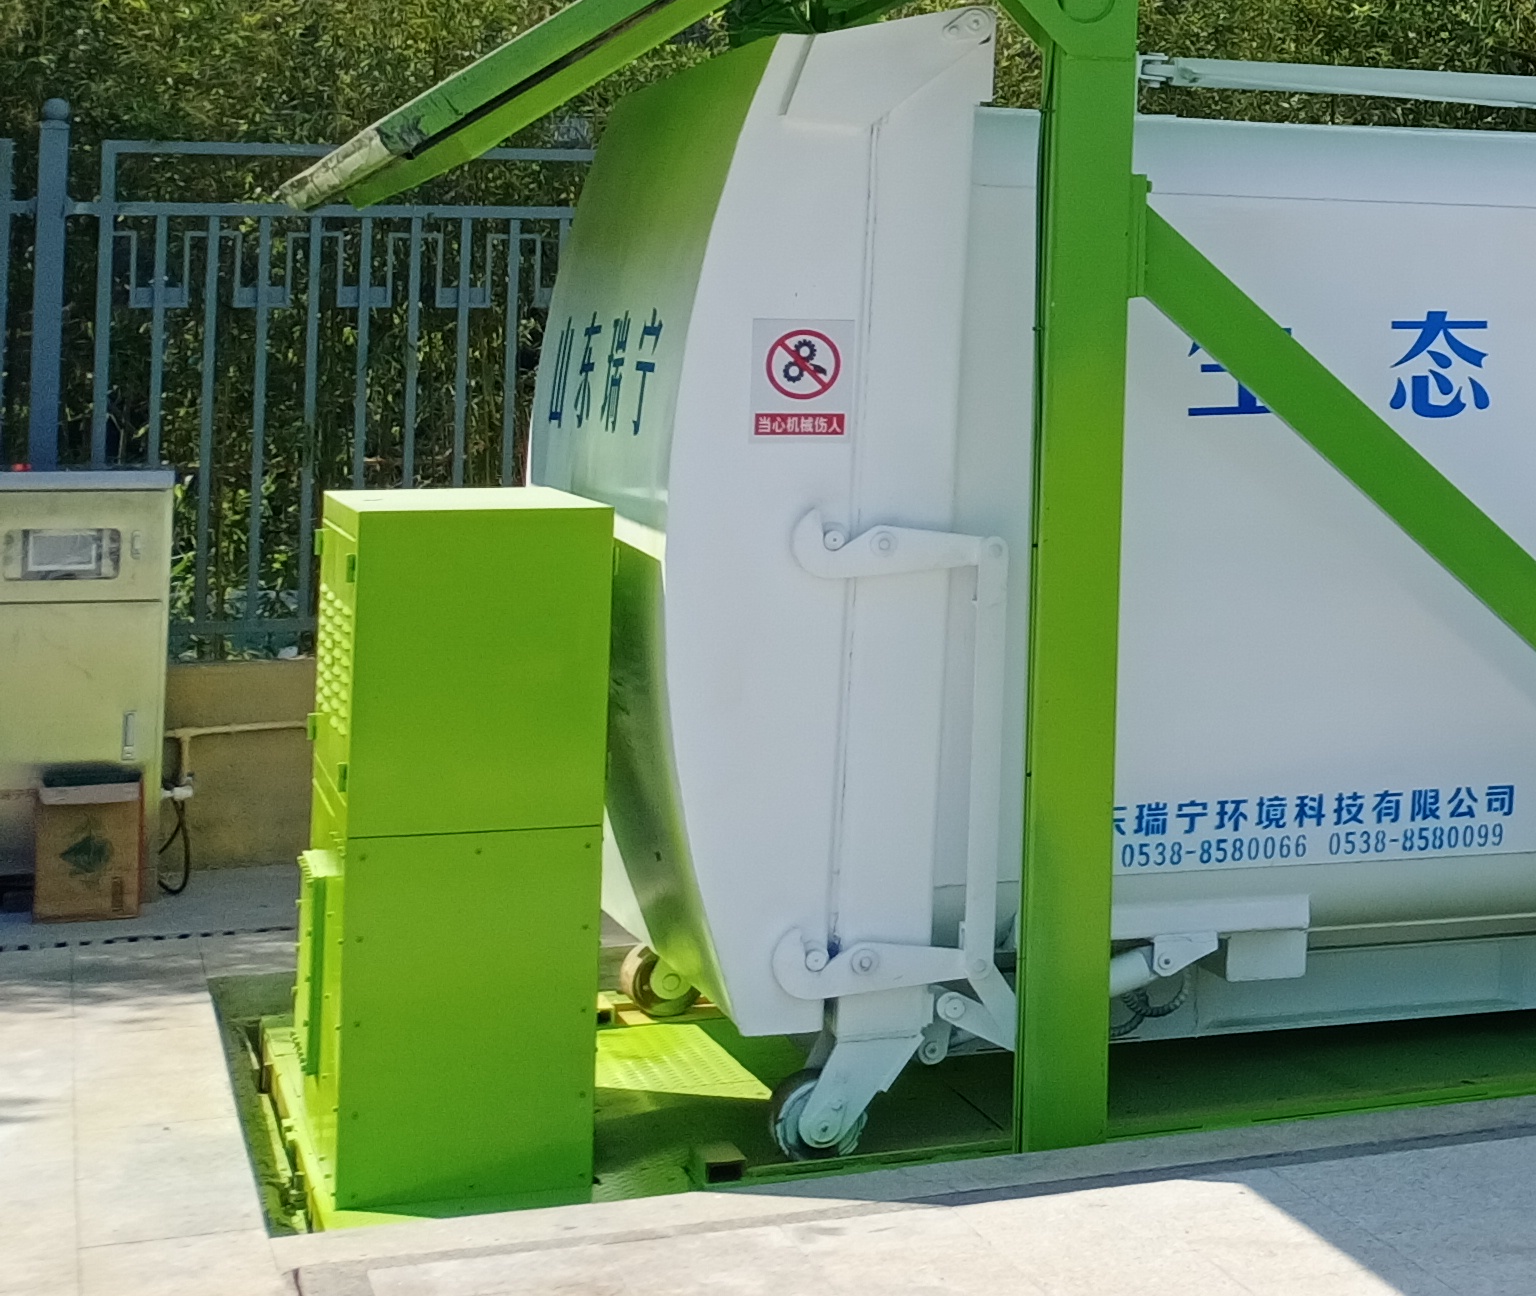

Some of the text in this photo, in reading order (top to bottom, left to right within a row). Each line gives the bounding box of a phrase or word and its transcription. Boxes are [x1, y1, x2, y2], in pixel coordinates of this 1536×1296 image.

[549, 308, 663, 436] 山东瑞宁
[757, 416, 842, 434] 当心机械伤人
[1121, 822, 1505, 868] 0538-8580066 0538-8580099
